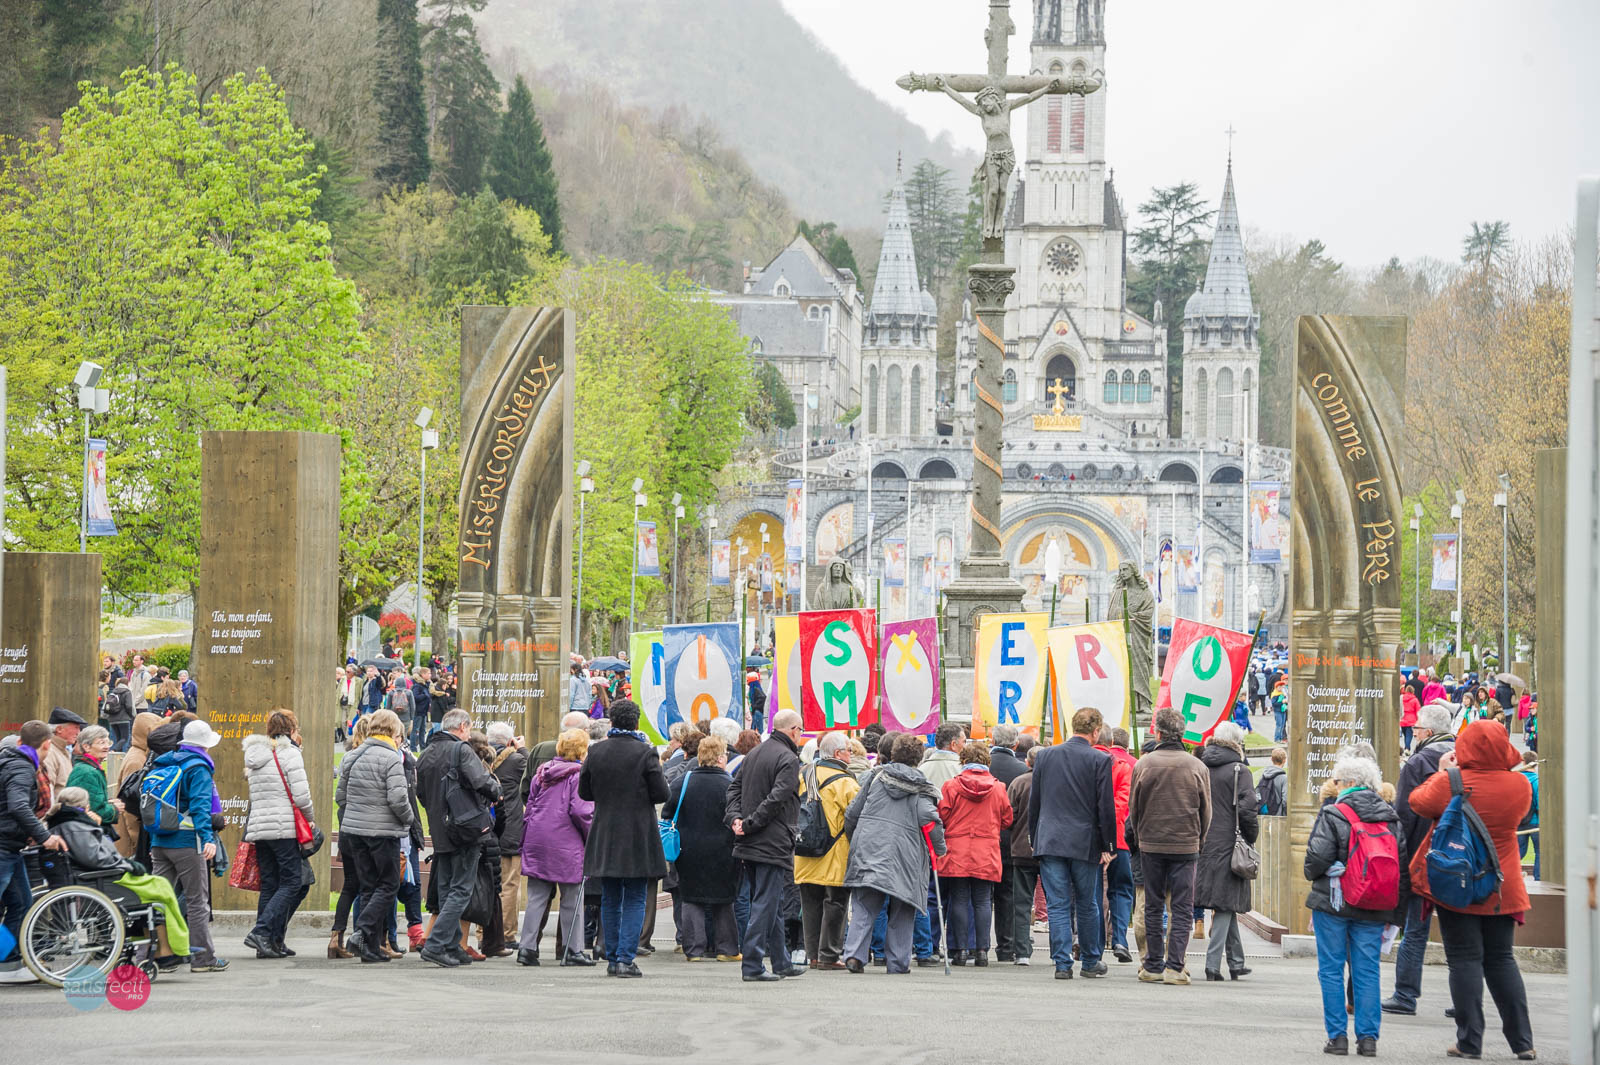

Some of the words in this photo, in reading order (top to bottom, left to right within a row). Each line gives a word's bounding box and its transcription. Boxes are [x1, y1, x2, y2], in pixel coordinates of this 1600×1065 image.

[211, 610, 226, 623] Toi,
[228, 613, 244, 622] mon
[246, 609, 273, 626] enfant,
[211, 628, 220, 638] tu
[221, 629, 229, 638] es
[231, 626, 261, 642] toujours
[211, 644, 228, 654] avec
[229, 642, 244, 654] moi
[824, 620, 852, 667] S
[890, 629, 922, 675] X
[1000, 622, 1025, 666] E
[1074, 634, 1108, 680] R
[1191, 635, 1222, 681] O
[471, 668, 509, 686] Chiunque
[495, 686, 545, 702] sperimentare
[1307, 684, 1350, 701] Quiconque
[1354, 687, 1384, 698] entrera
[471, 700, 499, 713] l'amore
[501, 701, 509, 713] di
[510, 702, 526, 714] Dio
[823, 680, 858, 728] M
[998, 680, 1022, 724] R
[1307, 703, 1336, 714] pourra
[1335, 700, 1357, 717] faire
[209, 710, 227, 722] Tout
[228, 712, 236, 722] ce
[238, 711, 250, 728] qui
[252, 712, 262, 722] est
[1355, 717, 1365, 730] de
[223, 728, 234, 738] est
[1306, 732, 1338, 745] l'amour
[1339, 732, 1349, 745] de
[1306, 749, 1321, 765] qui
[232, 812, 239, 824] is
